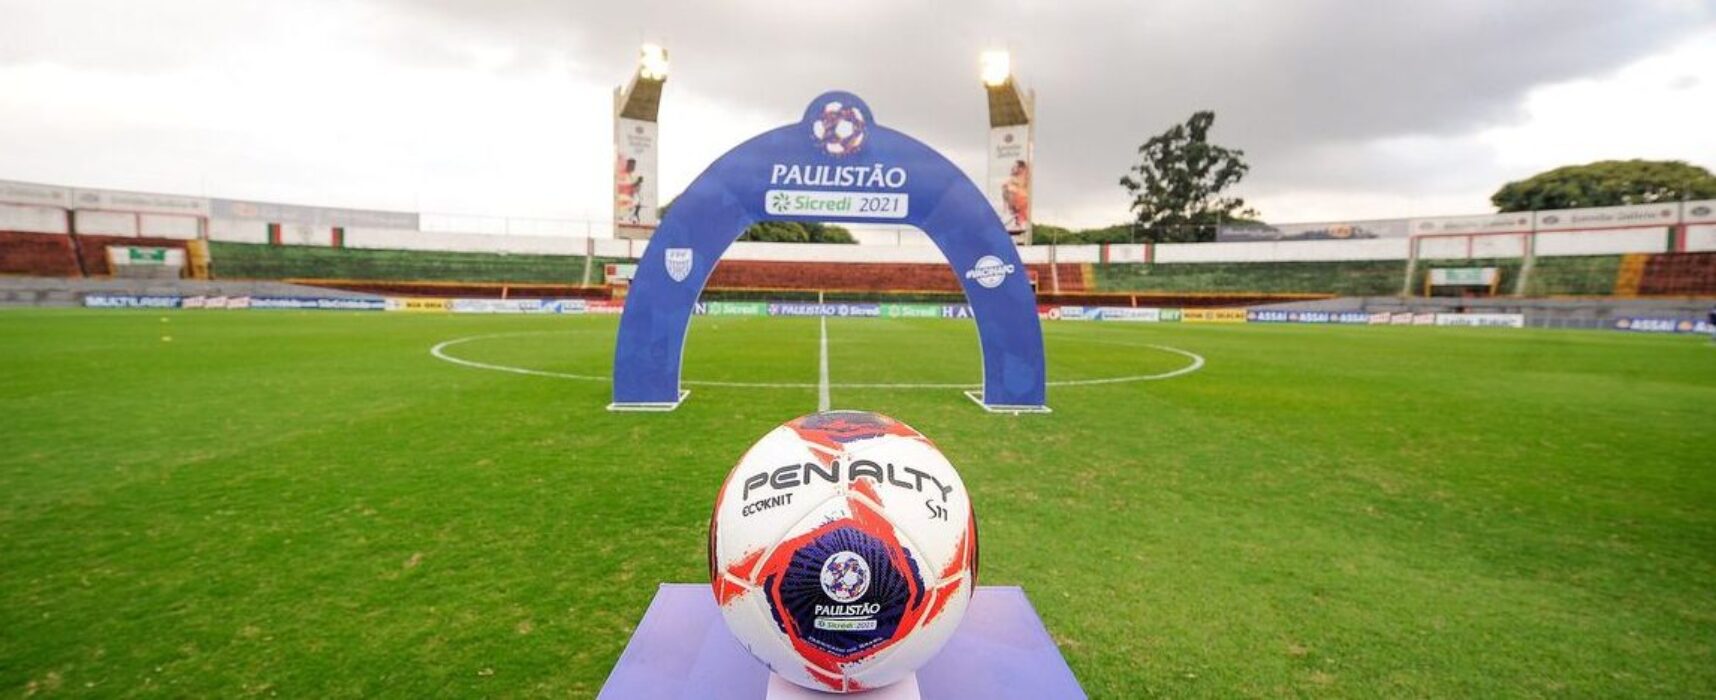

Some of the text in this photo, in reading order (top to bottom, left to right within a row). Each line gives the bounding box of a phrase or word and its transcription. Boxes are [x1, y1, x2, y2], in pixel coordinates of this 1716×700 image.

[770, 163, 907, 188] PAULISTÃO
[794, 195, 899, 212] Sicredi 2021
[722, 303, 760, 315] Sicredi
[780, 303, 880, 315] PAULISTÃO Sicredi
[742, 460, 953, 503] PENALTY
[814, 602, 881, 616] PAULISTÃO
